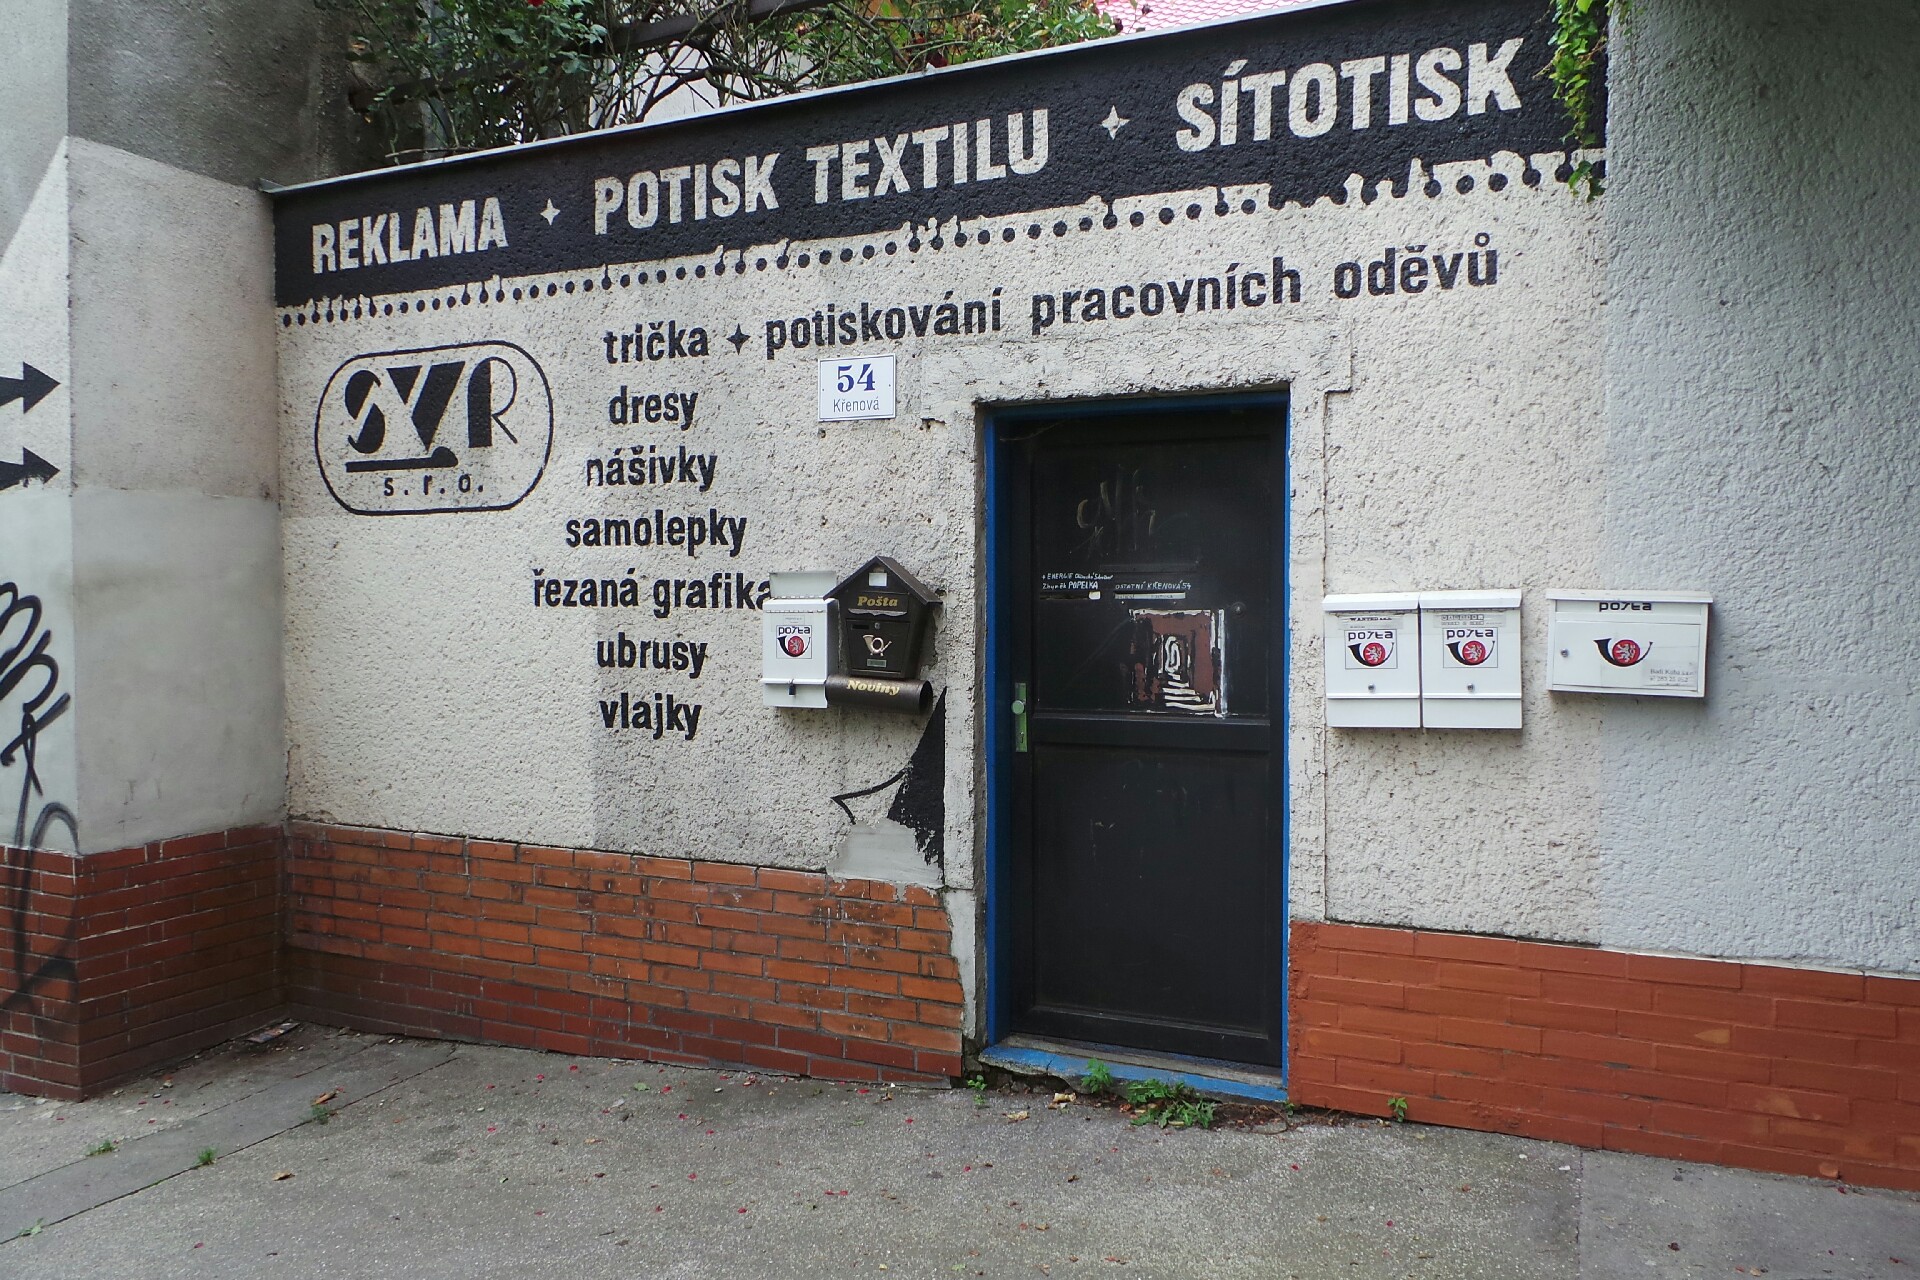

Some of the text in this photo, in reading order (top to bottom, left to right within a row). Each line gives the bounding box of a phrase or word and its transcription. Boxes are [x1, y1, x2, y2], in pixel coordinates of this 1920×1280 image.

[313, 38, 1523, 273] REKLAMA POTISK TEXTILU SÍTOTISK
[603, 232, 1498, 364] trička potiskování pracovních oděvů
[837, 363, 876, 393] 54
[609, 386, 698, 431] dresy
[833, 396, 880, 413] Křenová
[587, 445, 717, 492] nášivky
[566, 508, 747, 557] samolepky
[532, 568, 639, 608] řezaná
[857, 596, 899, 607] Pošta
[1068, 581, 1098, 590] POPELKA
[597, 632, 708, 679] ubrusy
[846, 679, 900, 695] Noviny
[599, 692, 702, 740] vlajky
